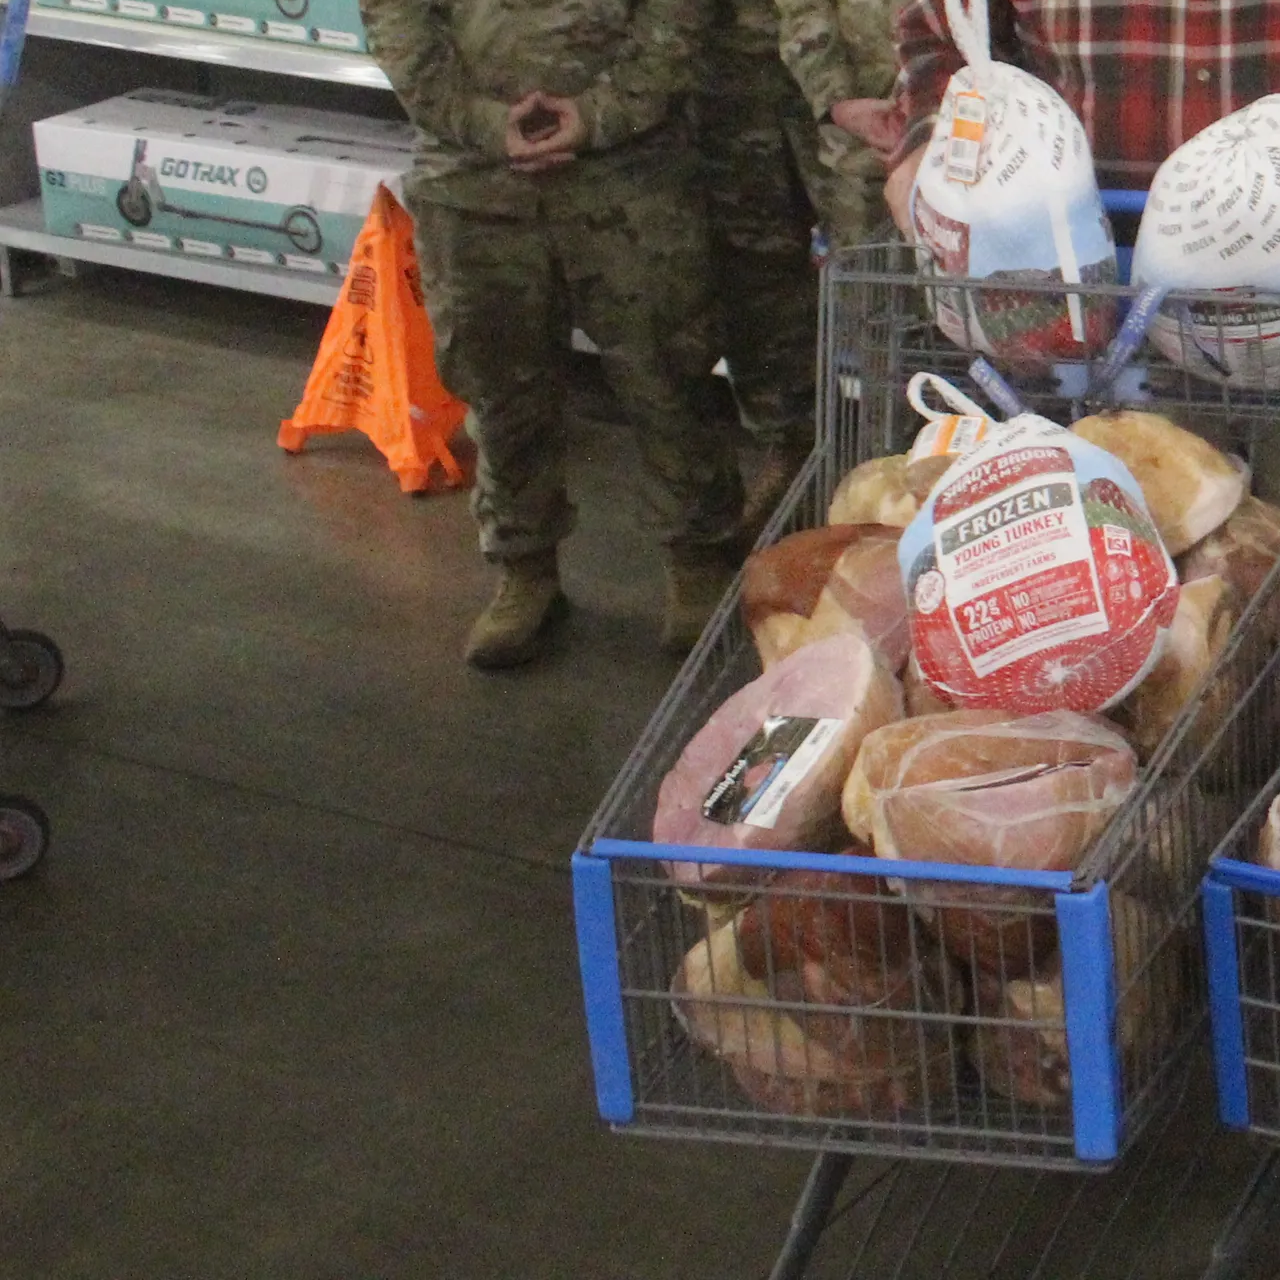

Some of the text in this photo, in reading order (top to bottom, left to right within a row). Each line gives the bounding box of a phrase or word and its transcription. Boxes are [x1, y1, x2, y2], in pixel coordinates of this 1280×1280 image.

[45, 169, 67, 188] G2
[160, 156, 240, 189] GOTRAX
[996, 146, 1030, 188] FROZEN
[1216, 185, 1245, 217] FROZEN
[1249, 172, 1266, 212] FROZEN
[1181, 234, 1218, 256] FROZEN
[1219, 231, 1255, 261] FROZEN
[970, 465, 1022, 493] FARMS
[956, 487, 1050, 543] FROZEN
[953, 533, 1002, 566] YOUNG
[1004, 511, 1065, 544] TURKEY
[1106, 536, 1131, 552] USA
[1026, 552, 1057, 573] FARMS
[962, 597, 1001, 631] 22g
[1011, 591, 1030, 611] NO
[966, 615, 1014, 647] PROTEIN
[1017, 611, 1036, 631] NO
